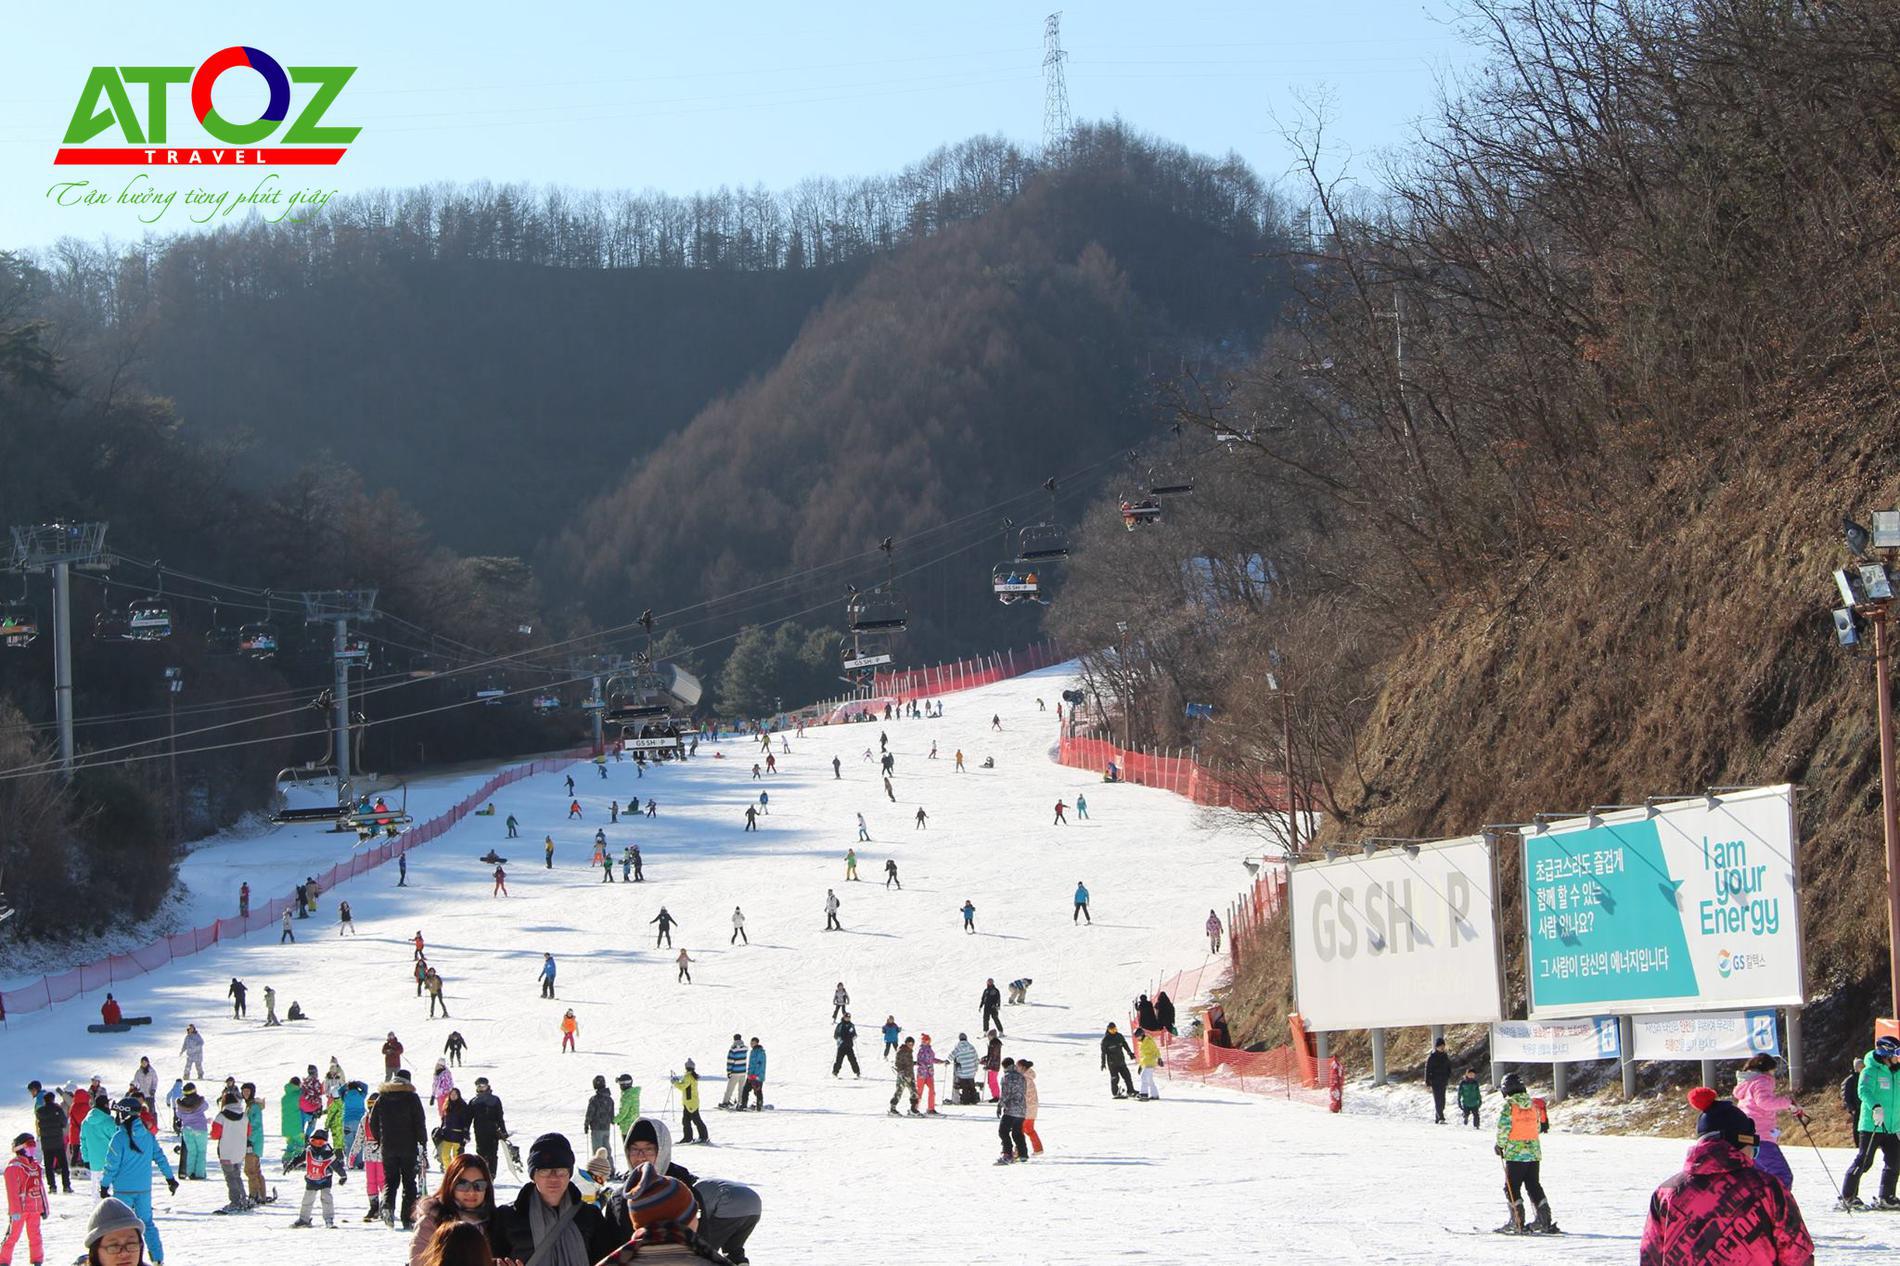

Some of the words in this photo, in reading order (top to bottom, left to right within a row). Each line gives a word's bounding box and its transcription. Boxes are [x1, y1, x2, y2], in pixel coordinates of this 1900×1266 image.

[863, 657, 880, 665] SHP
[1535, 853, 1592, 882] 초급코스라도
[1593, 848, 1625, 876] 즐겁게
[1703, 835, 1710, 871] I
[1714, 839, 1747, 869] am
[1536, 886, 1556, 912] 함께
[1557, 884, 1568, 910] 할
[1570, 883, 1581, 908] 수
[1582, 880, 1602, 906] 있는
[1714, 864, 1767, 906] your
[1312, 886, 1358, 963] GS
[1364, 871, 1471, 957] SHP
[1538, 914, 1557, 940] 사람
[1559, 911, 1595, 938] 있나요?
[1699, 897, 1780, 936] Energy
[1540, 959, 1550, 978] 그
[1552, 954, 1579, 979] 사람이
[1580, 951, 1609, 977] 당신의
[1610, 945, 1670, 975] 에너지입니다
[1732, 954, 1745, 970] GS
